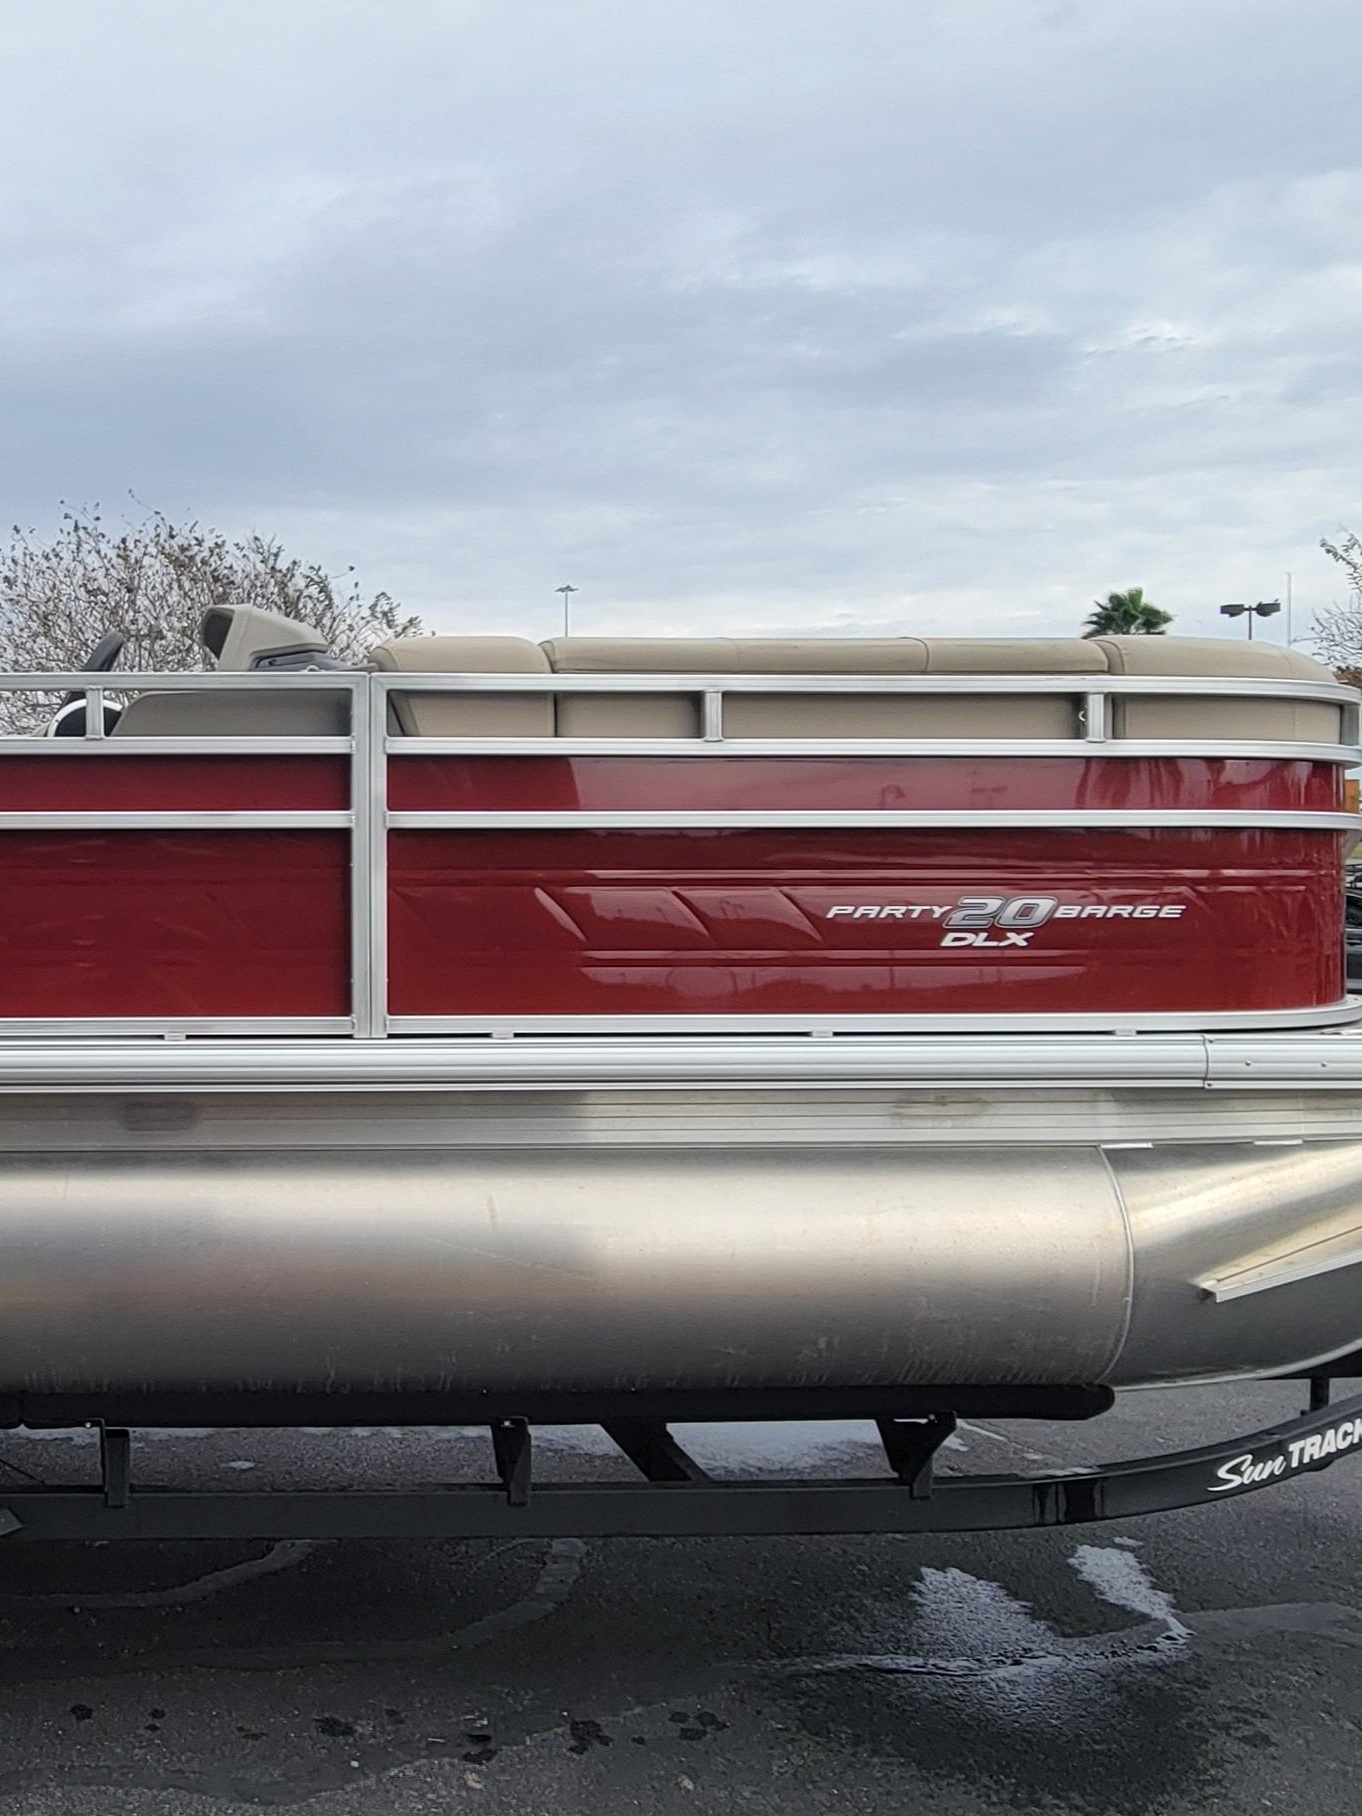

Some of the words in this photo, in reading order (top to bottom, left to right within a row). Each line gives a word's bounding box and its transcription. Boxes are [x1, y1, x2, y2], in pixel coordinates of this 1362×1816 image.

[826, 905, 952, 919] PARTY
[942, 896, 1059, 929] 20
[1053, 905, 1187, 919] BARGE
[939, 931, 1035, 947] DLX
[1207, 1454, 1287, 1492] Sun
